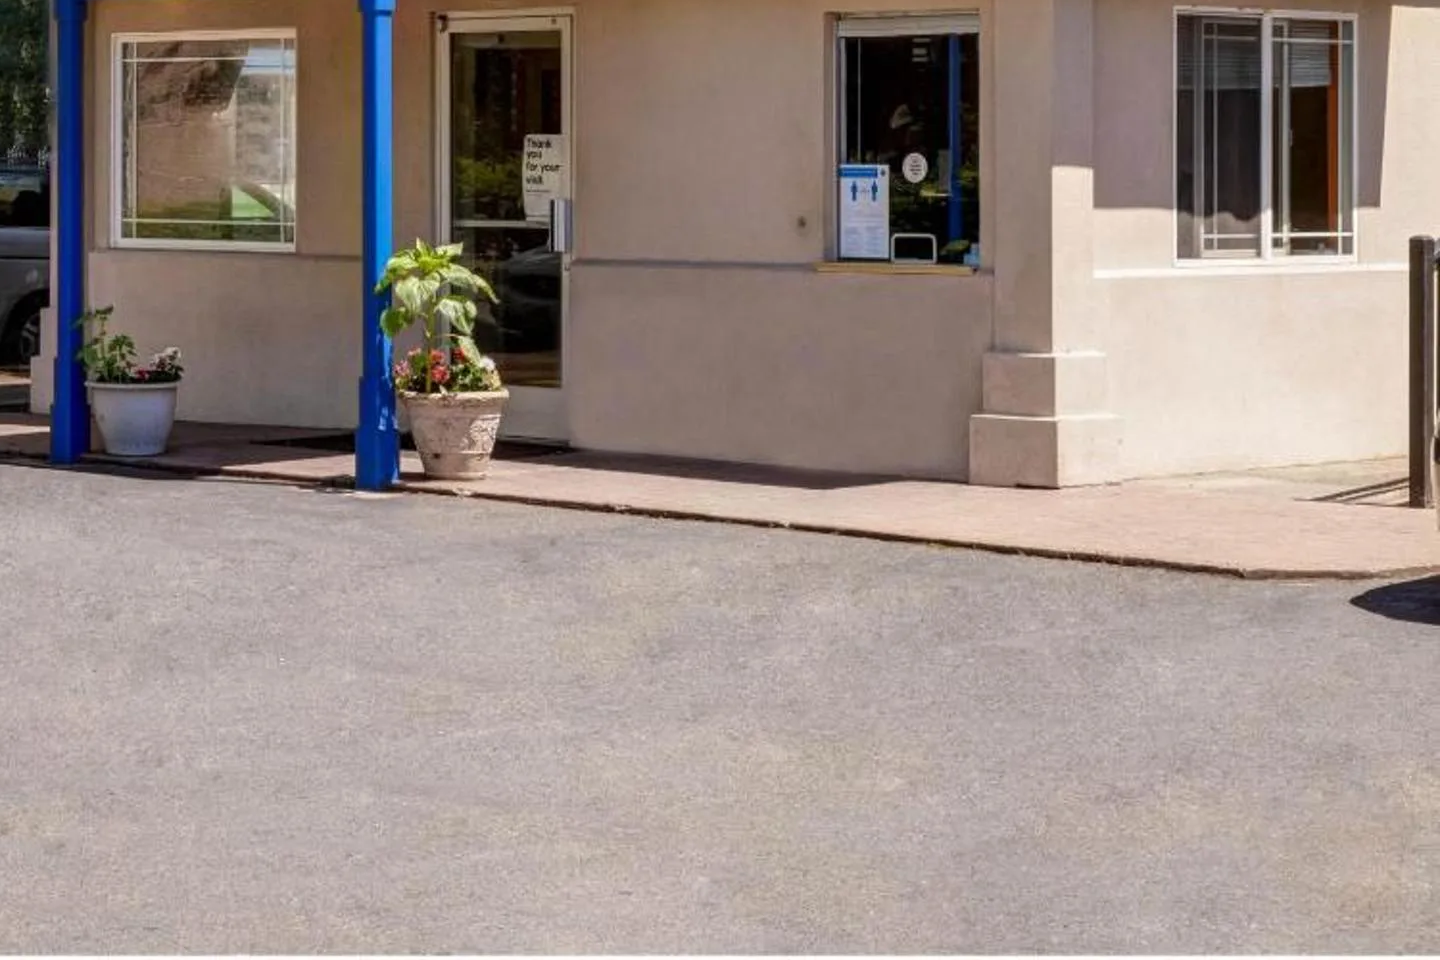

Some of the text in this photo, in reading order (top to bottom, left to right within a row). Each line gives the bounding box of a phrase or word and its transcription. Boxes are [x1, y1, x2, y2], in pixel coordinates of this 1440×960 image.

[526, 137, 552, 149] Thank
[526, 151, 542, 160] you
[526, 161, 561, 174] for your
